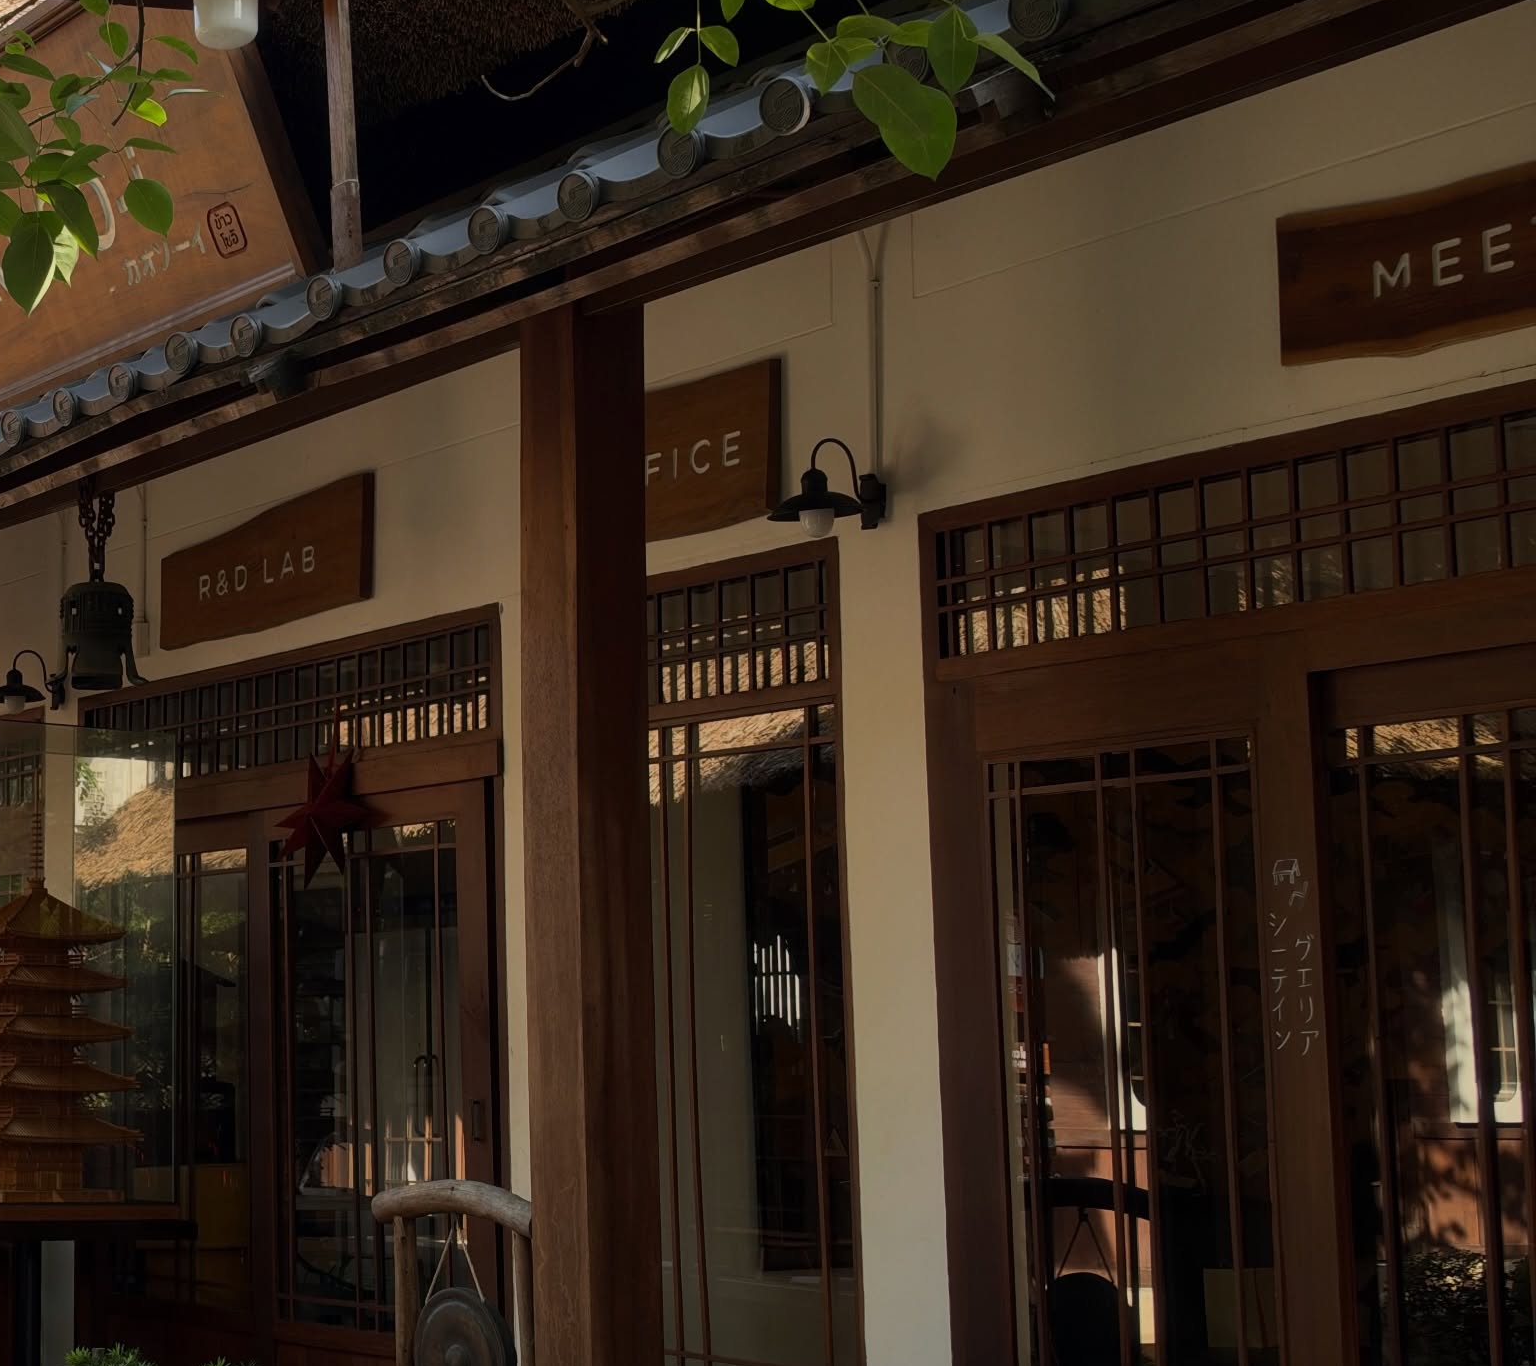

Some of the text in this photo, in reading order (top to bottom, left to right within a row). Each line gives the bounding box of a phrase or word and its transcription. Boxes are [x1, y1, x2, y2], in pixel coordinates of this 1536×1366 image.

[1372, 215, 1536, 299] MEE
[198, 545, 315, 602] R&D LAB
